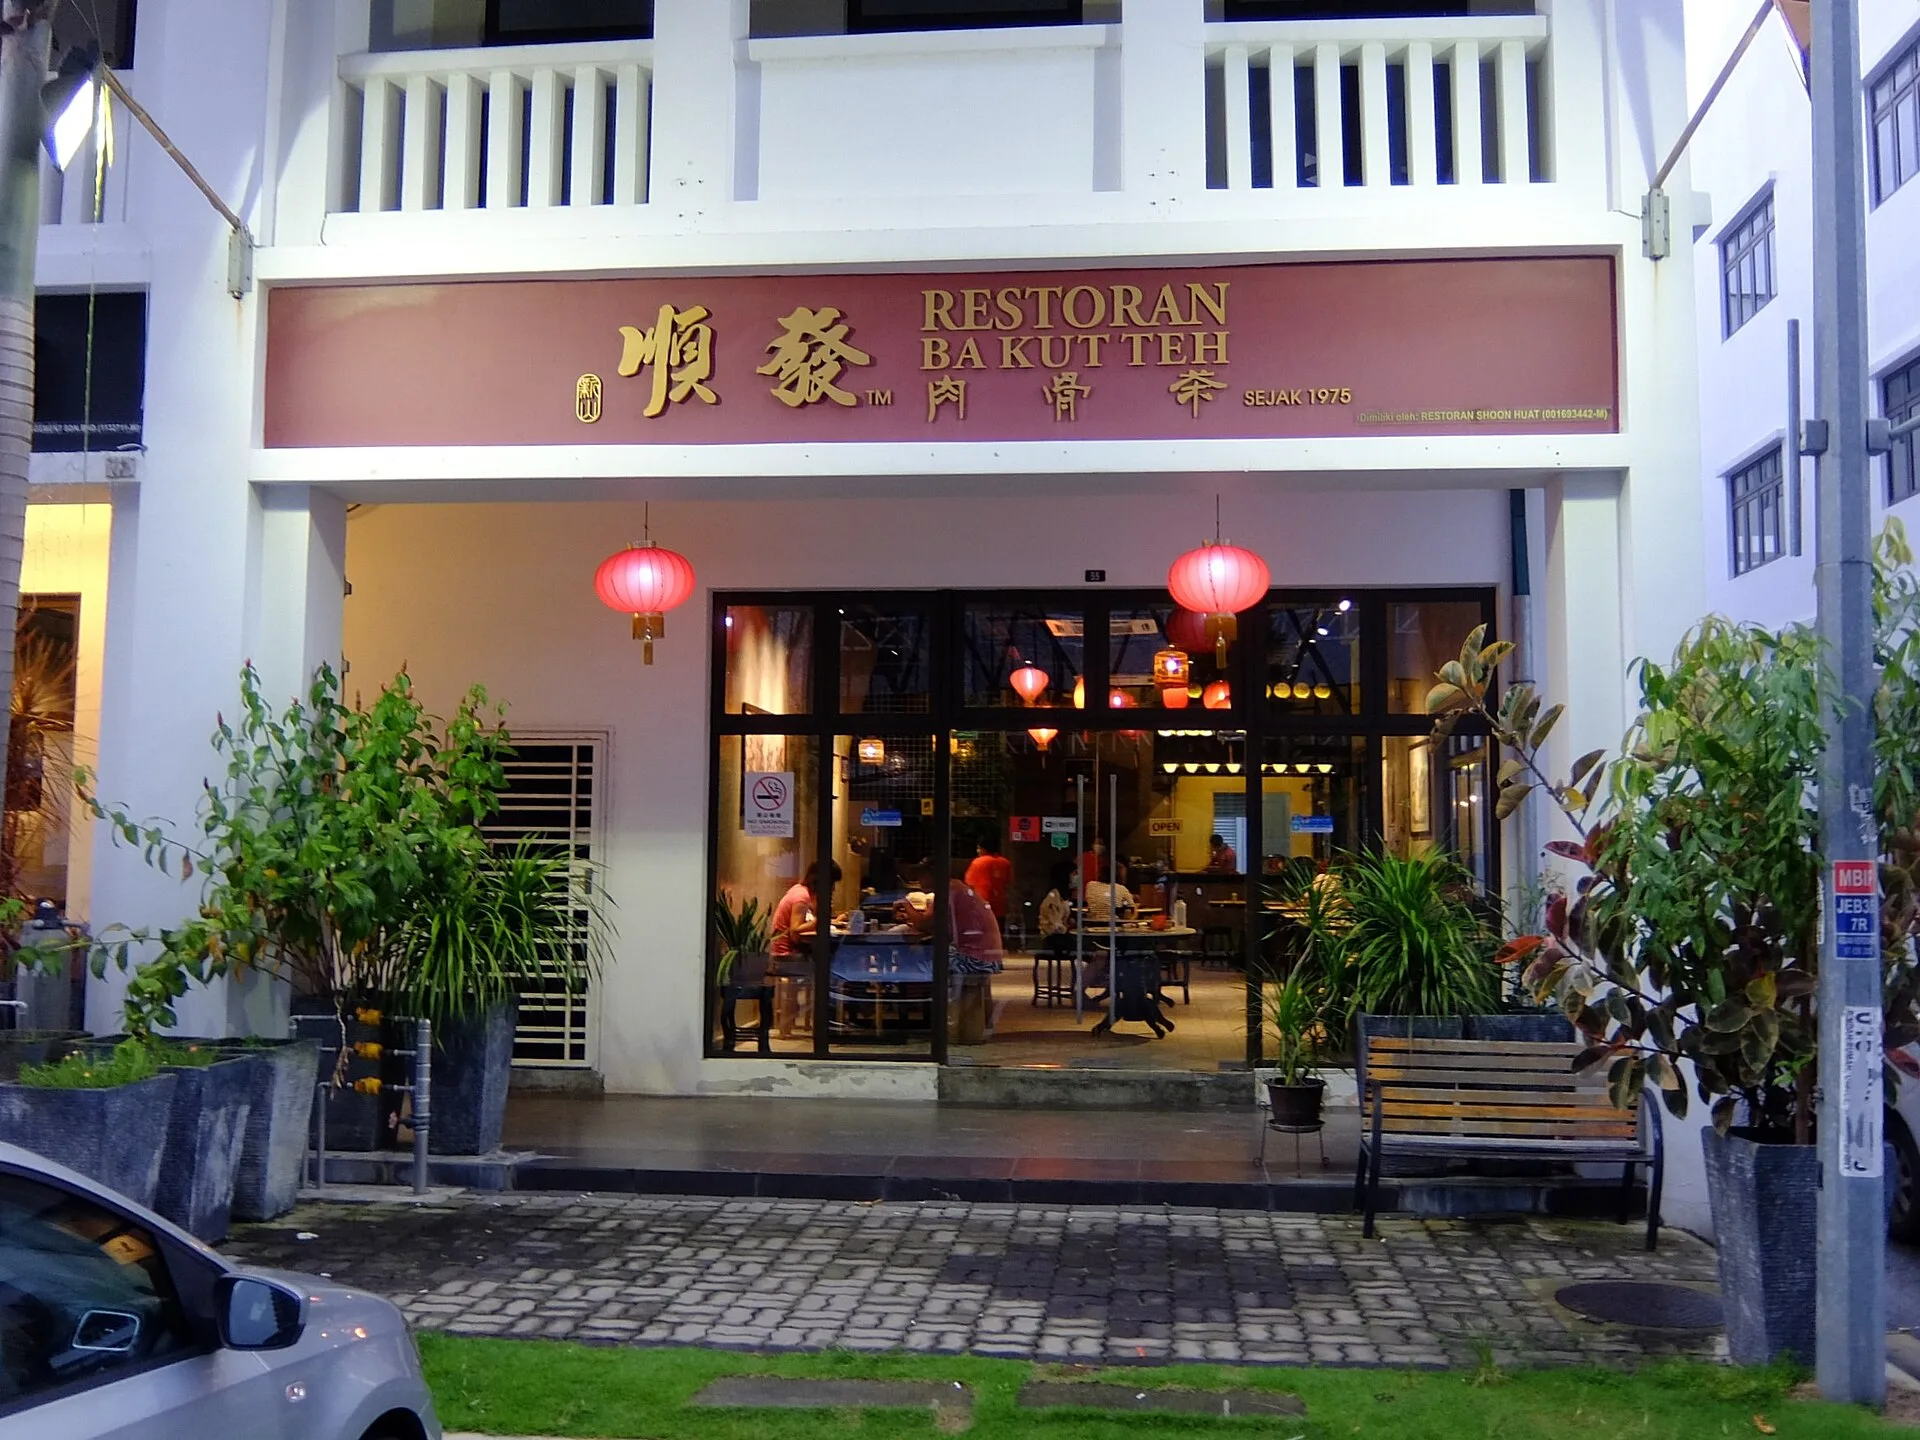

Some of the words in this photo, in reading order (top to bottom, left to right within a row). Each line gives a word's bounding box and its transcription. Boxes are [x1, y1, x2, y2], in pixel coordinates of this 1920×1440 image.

[921, 282, 1230, 331] RESTORAN
[920, 336, 987, 370] BA
[998, 333, 1110, 369] KUT
[1120, 331, 1230, 367] TEH
[617, 304, 871, 418] 順發
[868, 389, 892, 406] TM
[1243, 388, 1303, 407] SEJAK
[1308, 387, 1352, 405] 1975
[1421, 410, 1474, 421] RESTORAN
[1476, 409, 1512, 420] SHOON
[1513, 409, 1540, 419] HUAT
[1152, 822, 1181, 832] OPEN
[1850, 917, 1868, 931] 7R
